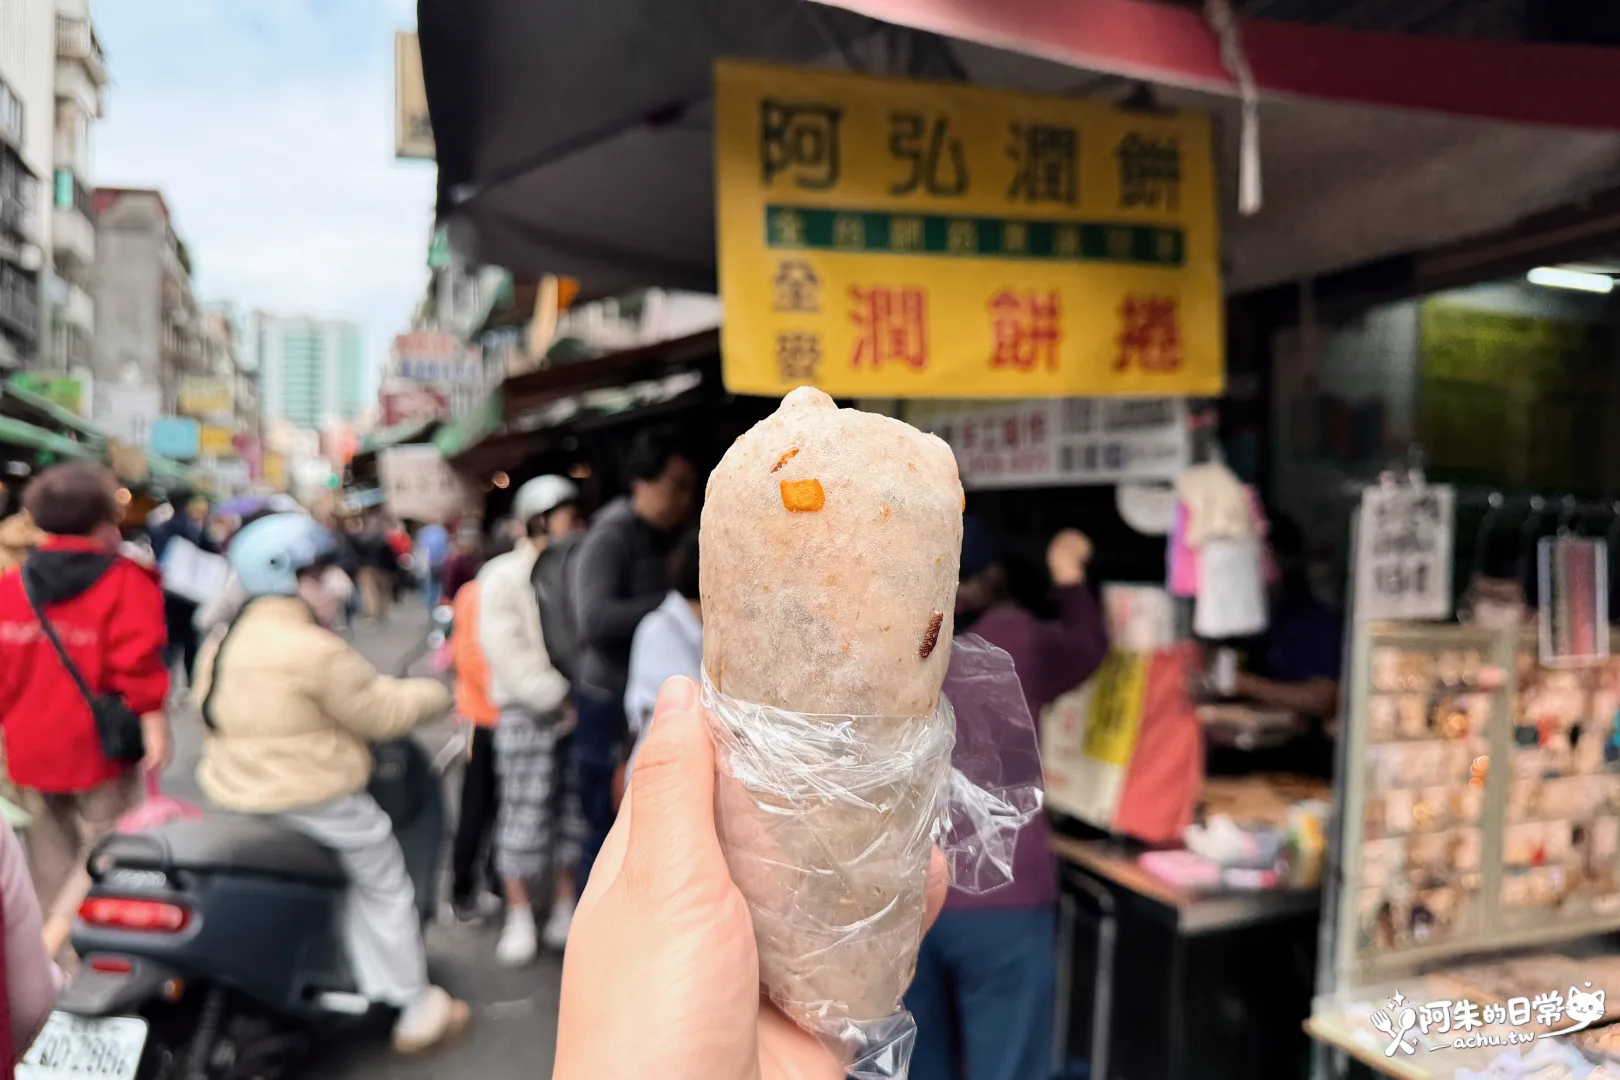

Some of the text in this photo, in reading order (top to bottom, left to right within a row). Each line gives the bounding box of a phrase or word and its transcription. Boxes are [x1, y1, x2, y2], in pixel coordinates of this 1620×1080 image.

[761, 99, 1182, 209] 阿弘潤餅
[849, 285, 1184, 371] 潤餅捲
